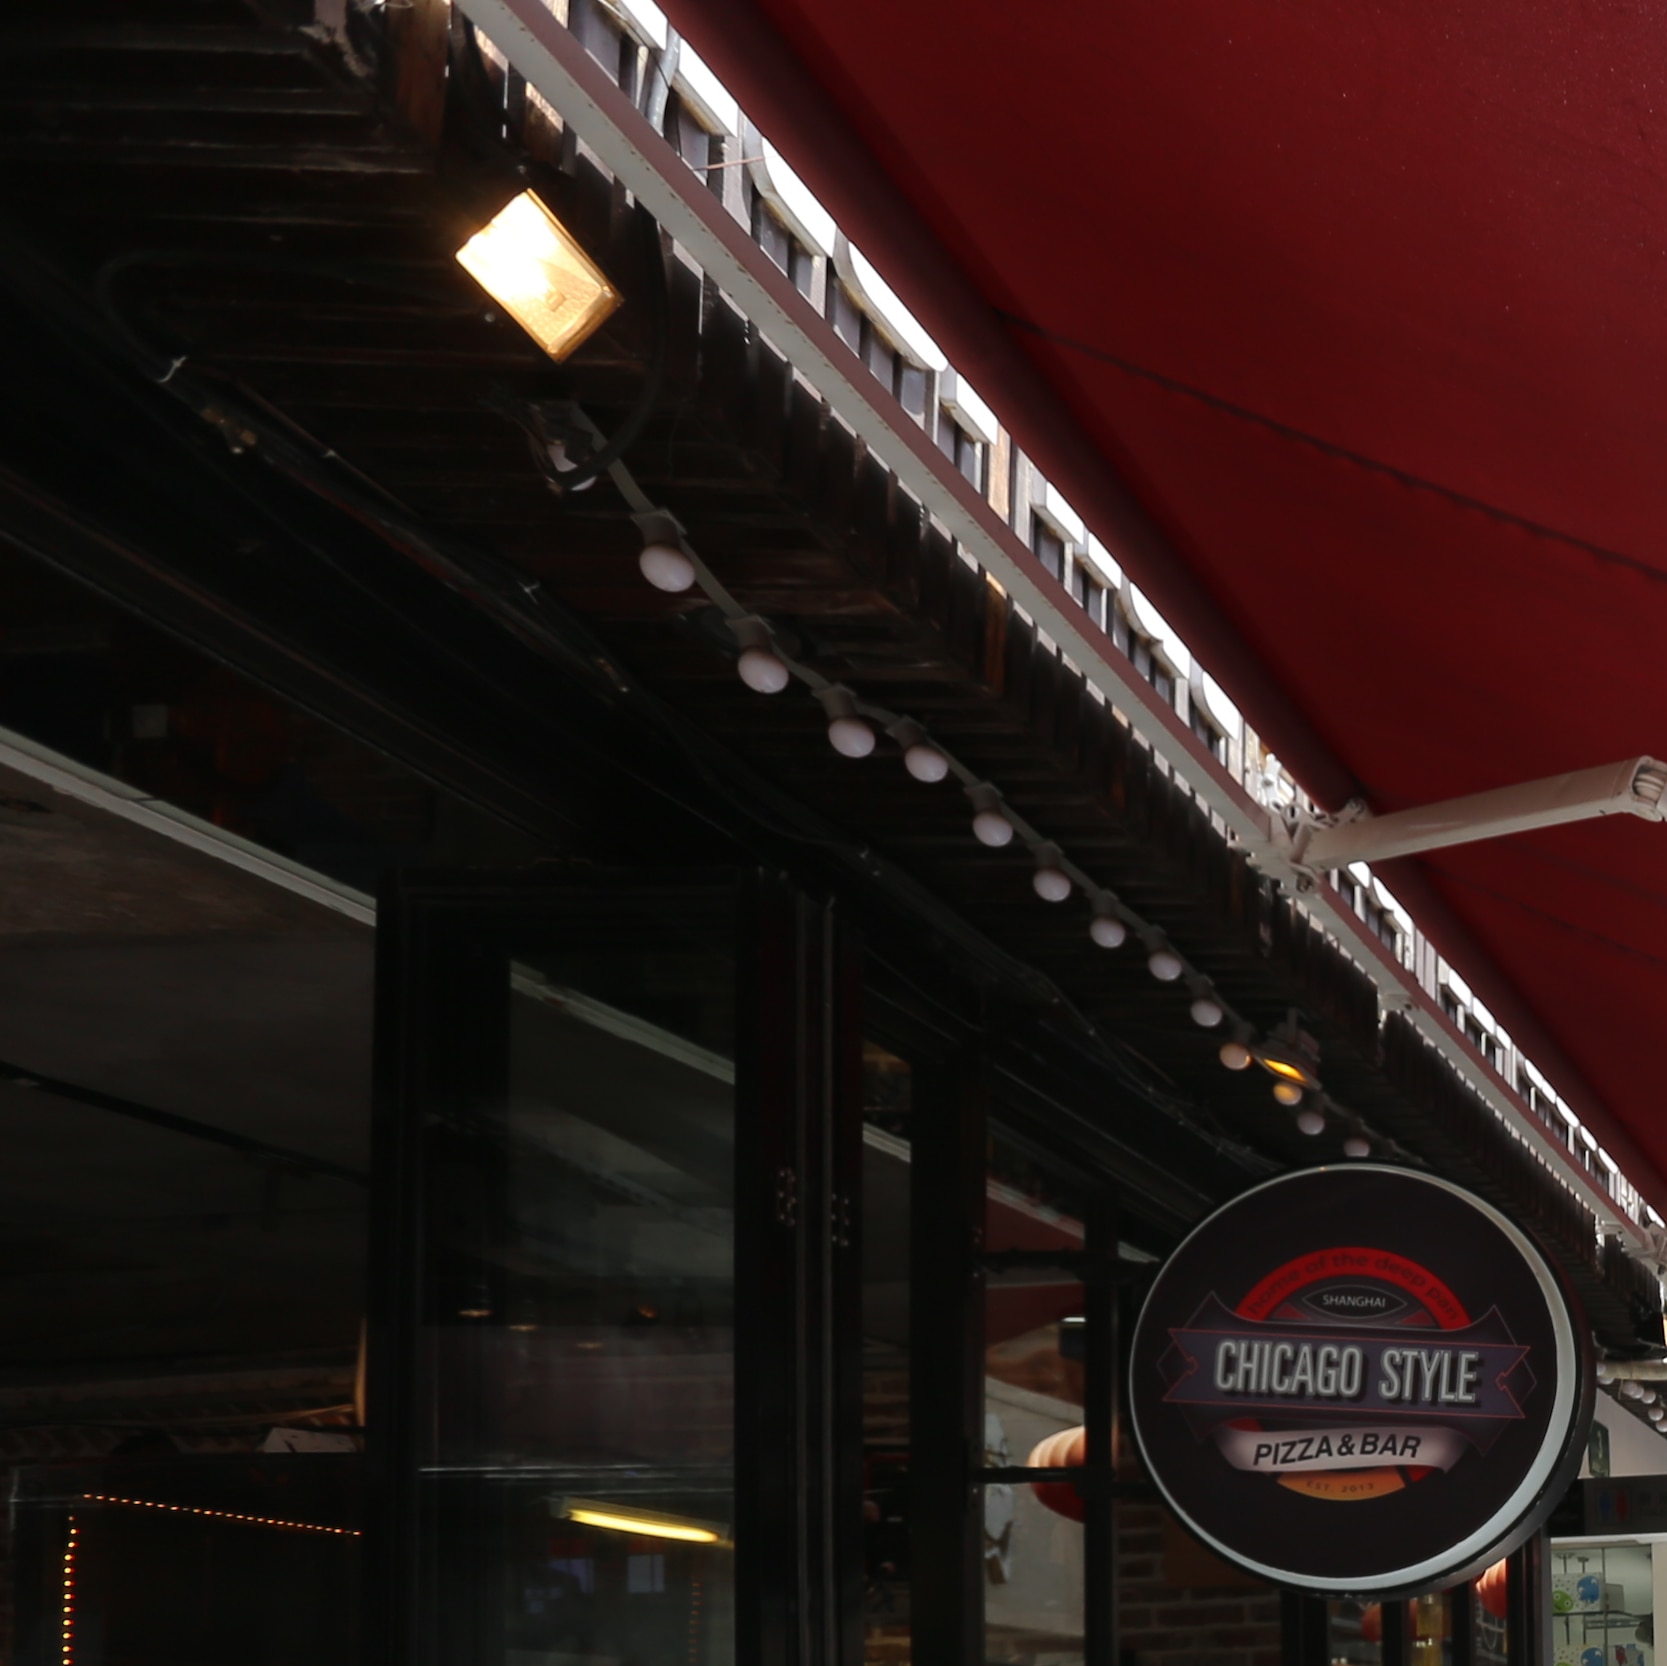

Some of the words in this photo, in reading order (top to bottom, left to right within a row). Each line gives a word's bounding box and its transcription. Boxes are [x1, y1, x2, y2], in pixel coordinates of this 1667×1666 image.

[1248, 1269, 1301, 1316] home
[1304, 1256, 1328, 1274] of
[1332, 1251, 1369, 1268] the
[1374, 1254, 1426, 1287] deep
[1322, 1294, 1387, 1309] SHANGHAI
[1214, 1339, 1363, 1398] CHICAGO
[1379, 1347, 1480, 1404] STYLE
[1341, 1481, 1375, 1494] 2013
